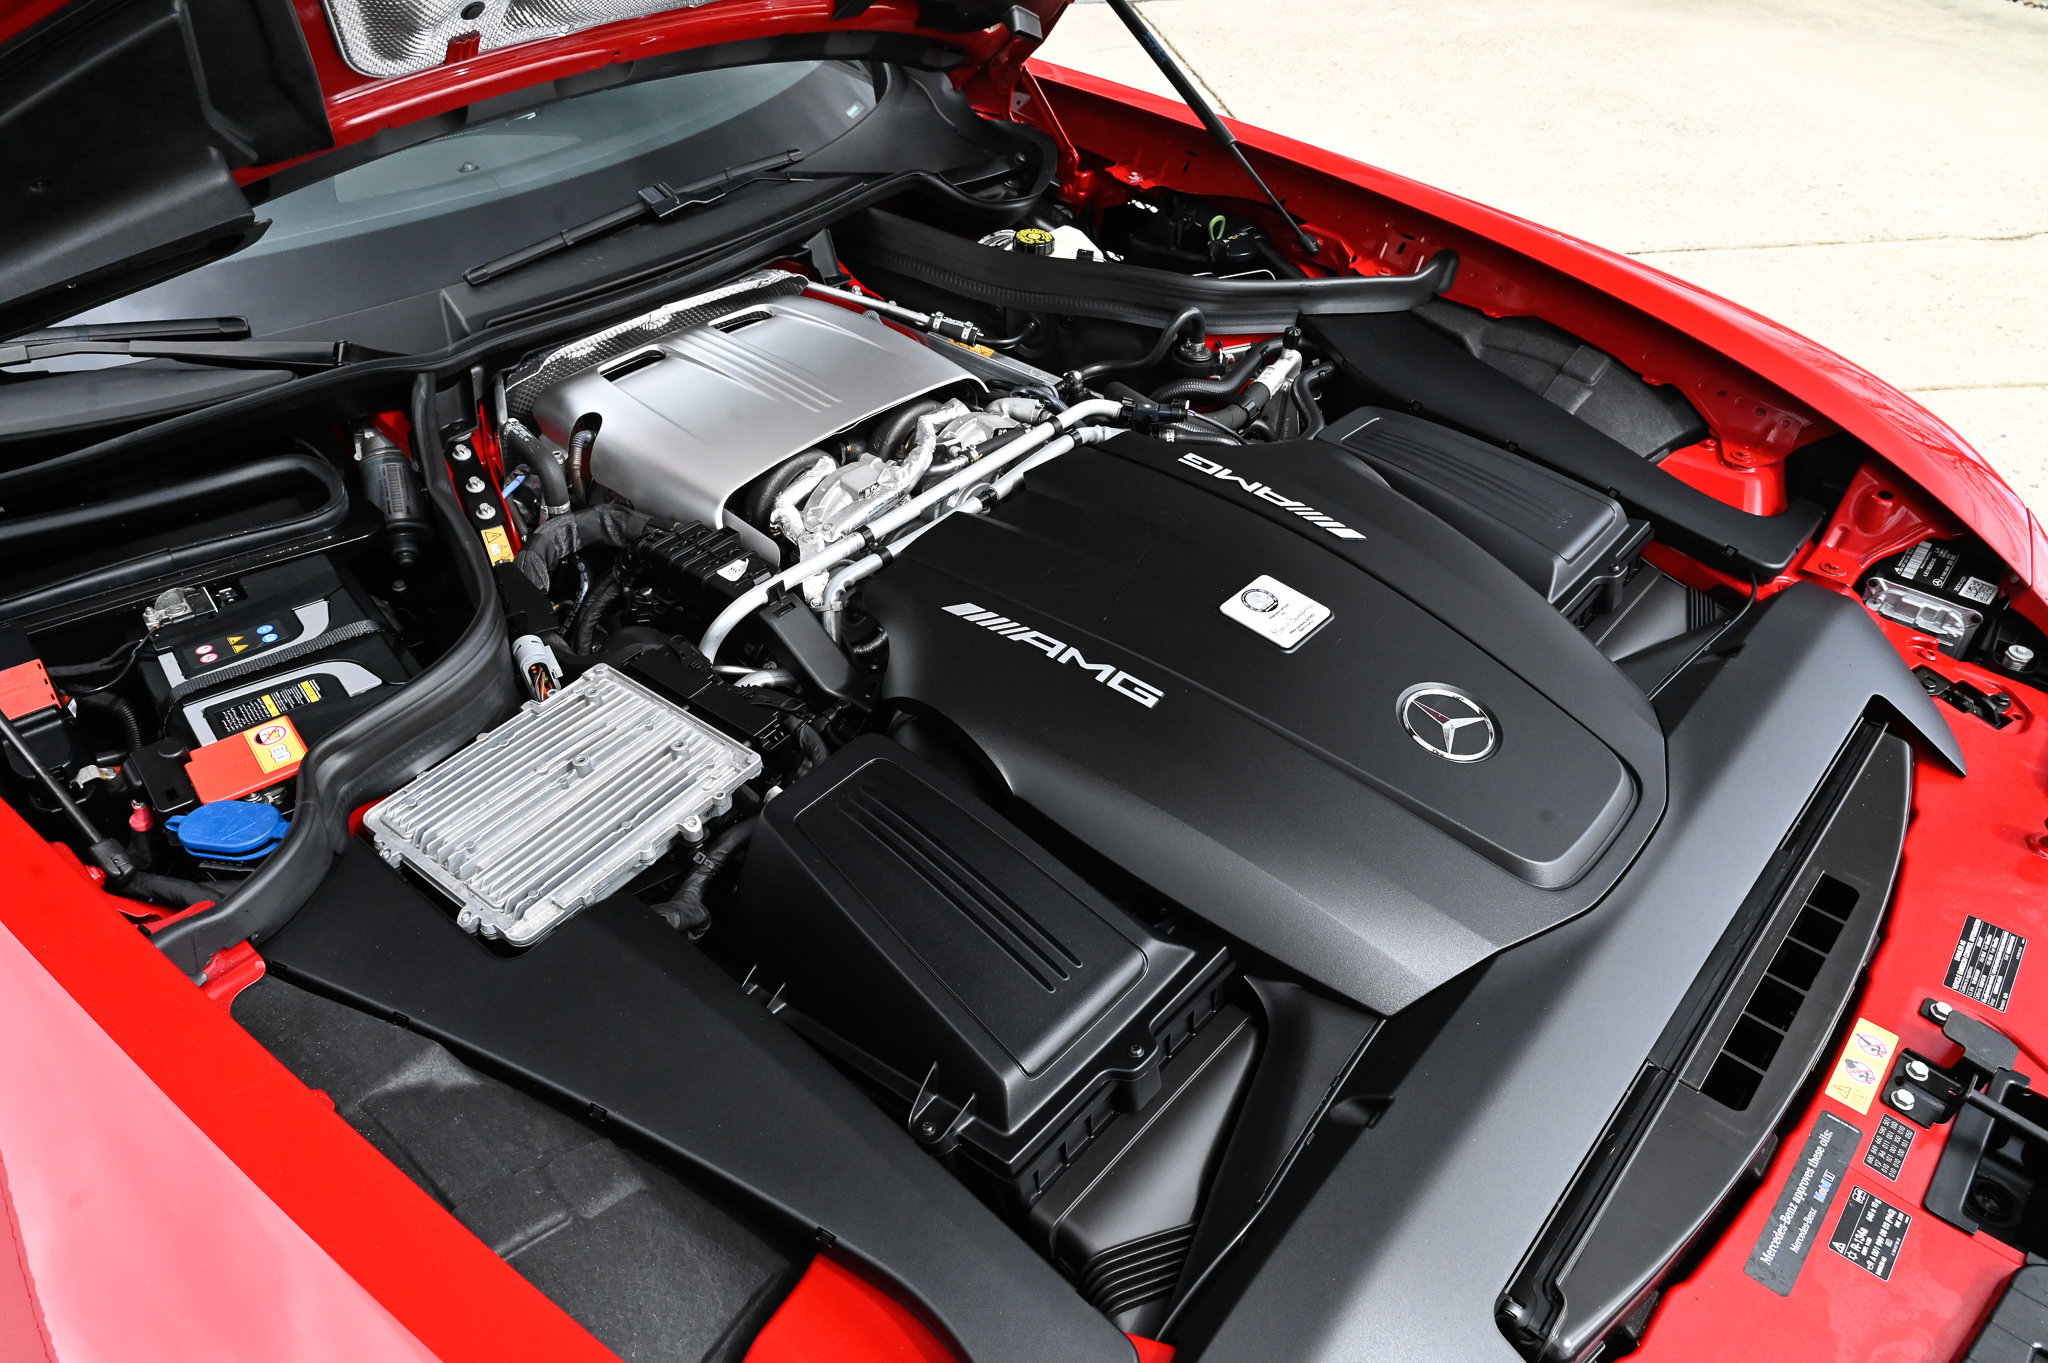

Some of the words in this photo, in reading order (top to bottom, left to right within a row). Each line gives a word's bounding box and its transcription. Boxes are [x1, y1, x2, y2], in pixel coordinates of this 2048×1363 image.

[1178, 452, 1306, 506] AMG
[1007, 630, 1164, 708] AMG
[1760, 1201, 1799, 1266] Mercedes-Benz
[1792, 1166, 1815, 1205] approves
[1808, 1146, 1826, 1168] these
[1819, 1129, 1834, 1148] oils:
[1789, 1207, 1817, 1254] Mercedes-Benz
[1813, 1178, 1833, 1203] Mobil
[1850, 1227, 1868, 1252] R-134a
